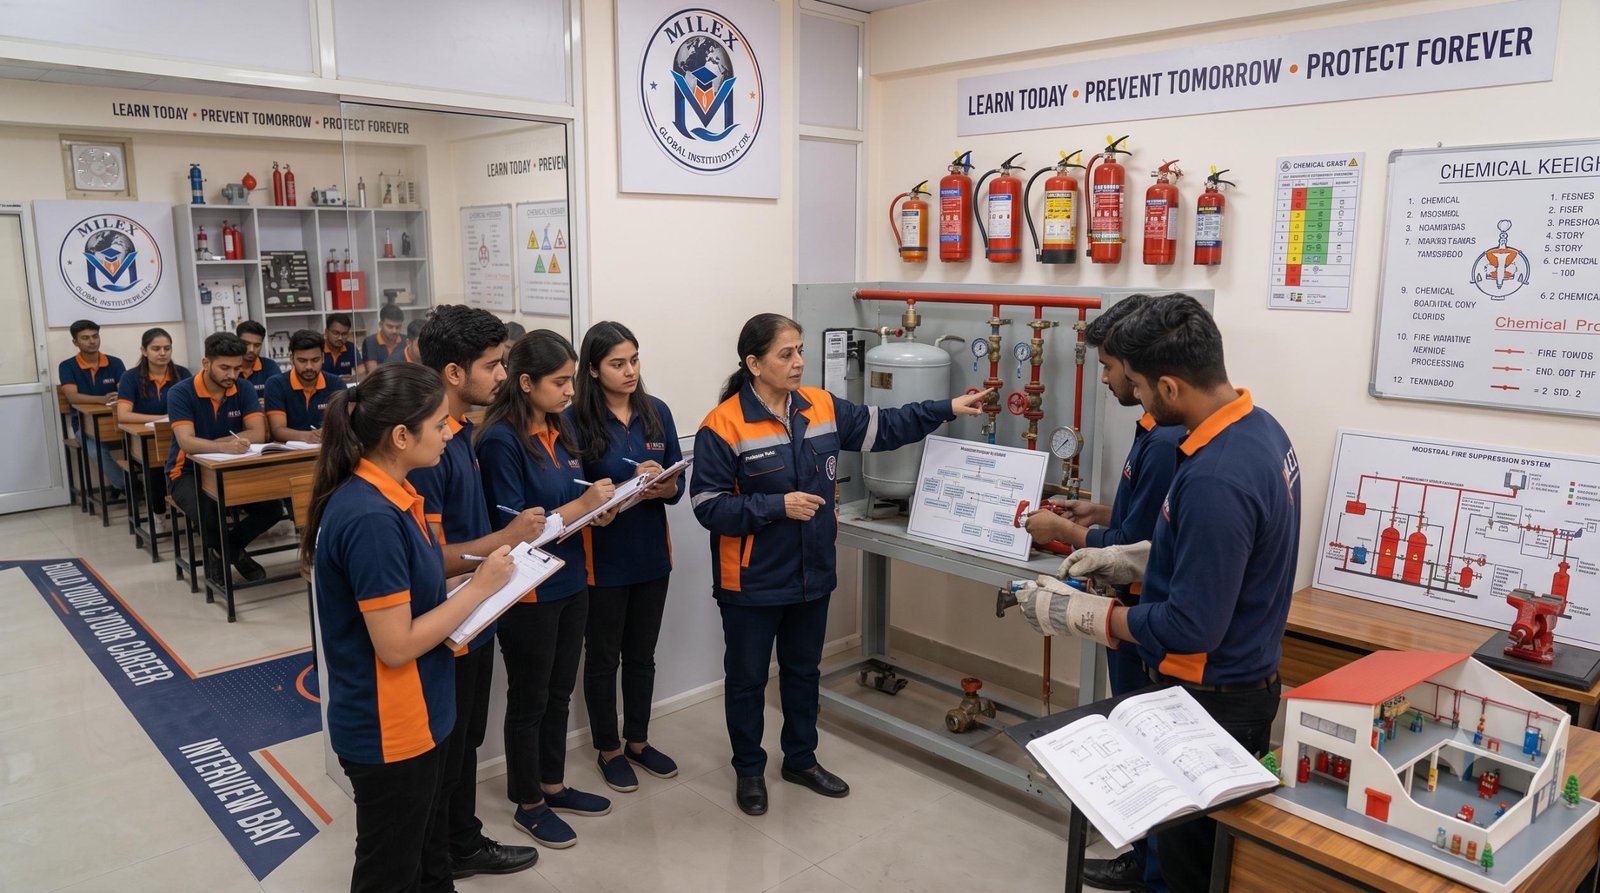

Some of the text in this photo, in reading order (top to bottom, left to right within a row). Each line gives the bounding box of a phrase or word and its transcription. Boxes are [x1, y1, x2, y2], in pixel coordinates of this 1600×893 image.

[664, 15, 740, 52] MILEX
[968, 26, 1534, 117] LEARN TODAY PREVENT TOMORROW PROTECT FOREVER
[112, 102, 410, 135] LEARN TODAY PREVENT TOMORROW PROTECT FOREVER
[659, 126, 686, 158] GLOBAL
[487, 162, 508, 177] LEARN
[509, 159, 531, 175] TODAY
[1440, 160, 1532, 179] CHEMICAL
[1421, 196, 1460, 204] CHEMICAL
[1548, 206, 1556, 214] 2.
[76, 218, 140, 238] MILEX
[1406, 224, 1412, 232] 3.
[1405, 238, 1411, 246] 7.
[1556, 232, 1584, 240] STORY
[1544, 244, 1583, 252] 5. STORY
[1560, 269, 1575, 277] 100
[75, 285, 98, 304] GLOBAL
[1401, 286, 1455, 295] 9. CHEMICAL
[1412, 312, 1445, 320] CLORIDS
[1495, 316, 1566, 330] Chemical
[1414, 334, 1430, 342] FIRE
[1538, 349, 1557, 358] FIRE
[1411, 358, 1464, 368] PROCEESSING
[1393, 376, 1404, 384] 12.
[1580, 370, 1596, 379] THF
[1542, 387, 1548, 395] 2
[1576, 390, 1581, 398] 2
[1468, 452, 1519, 464] SUPPRESSION
[1521, 459, 1551, 468] SYSTEM
[41, 561, 88, 586] BUILD
[60, 582, 108, 609] YOUR
[84, 611, 137, 643] YOUR
[107, 640, 174, 686] CAREER
[178, 737, 301, 846] INTERVIEW BAY
